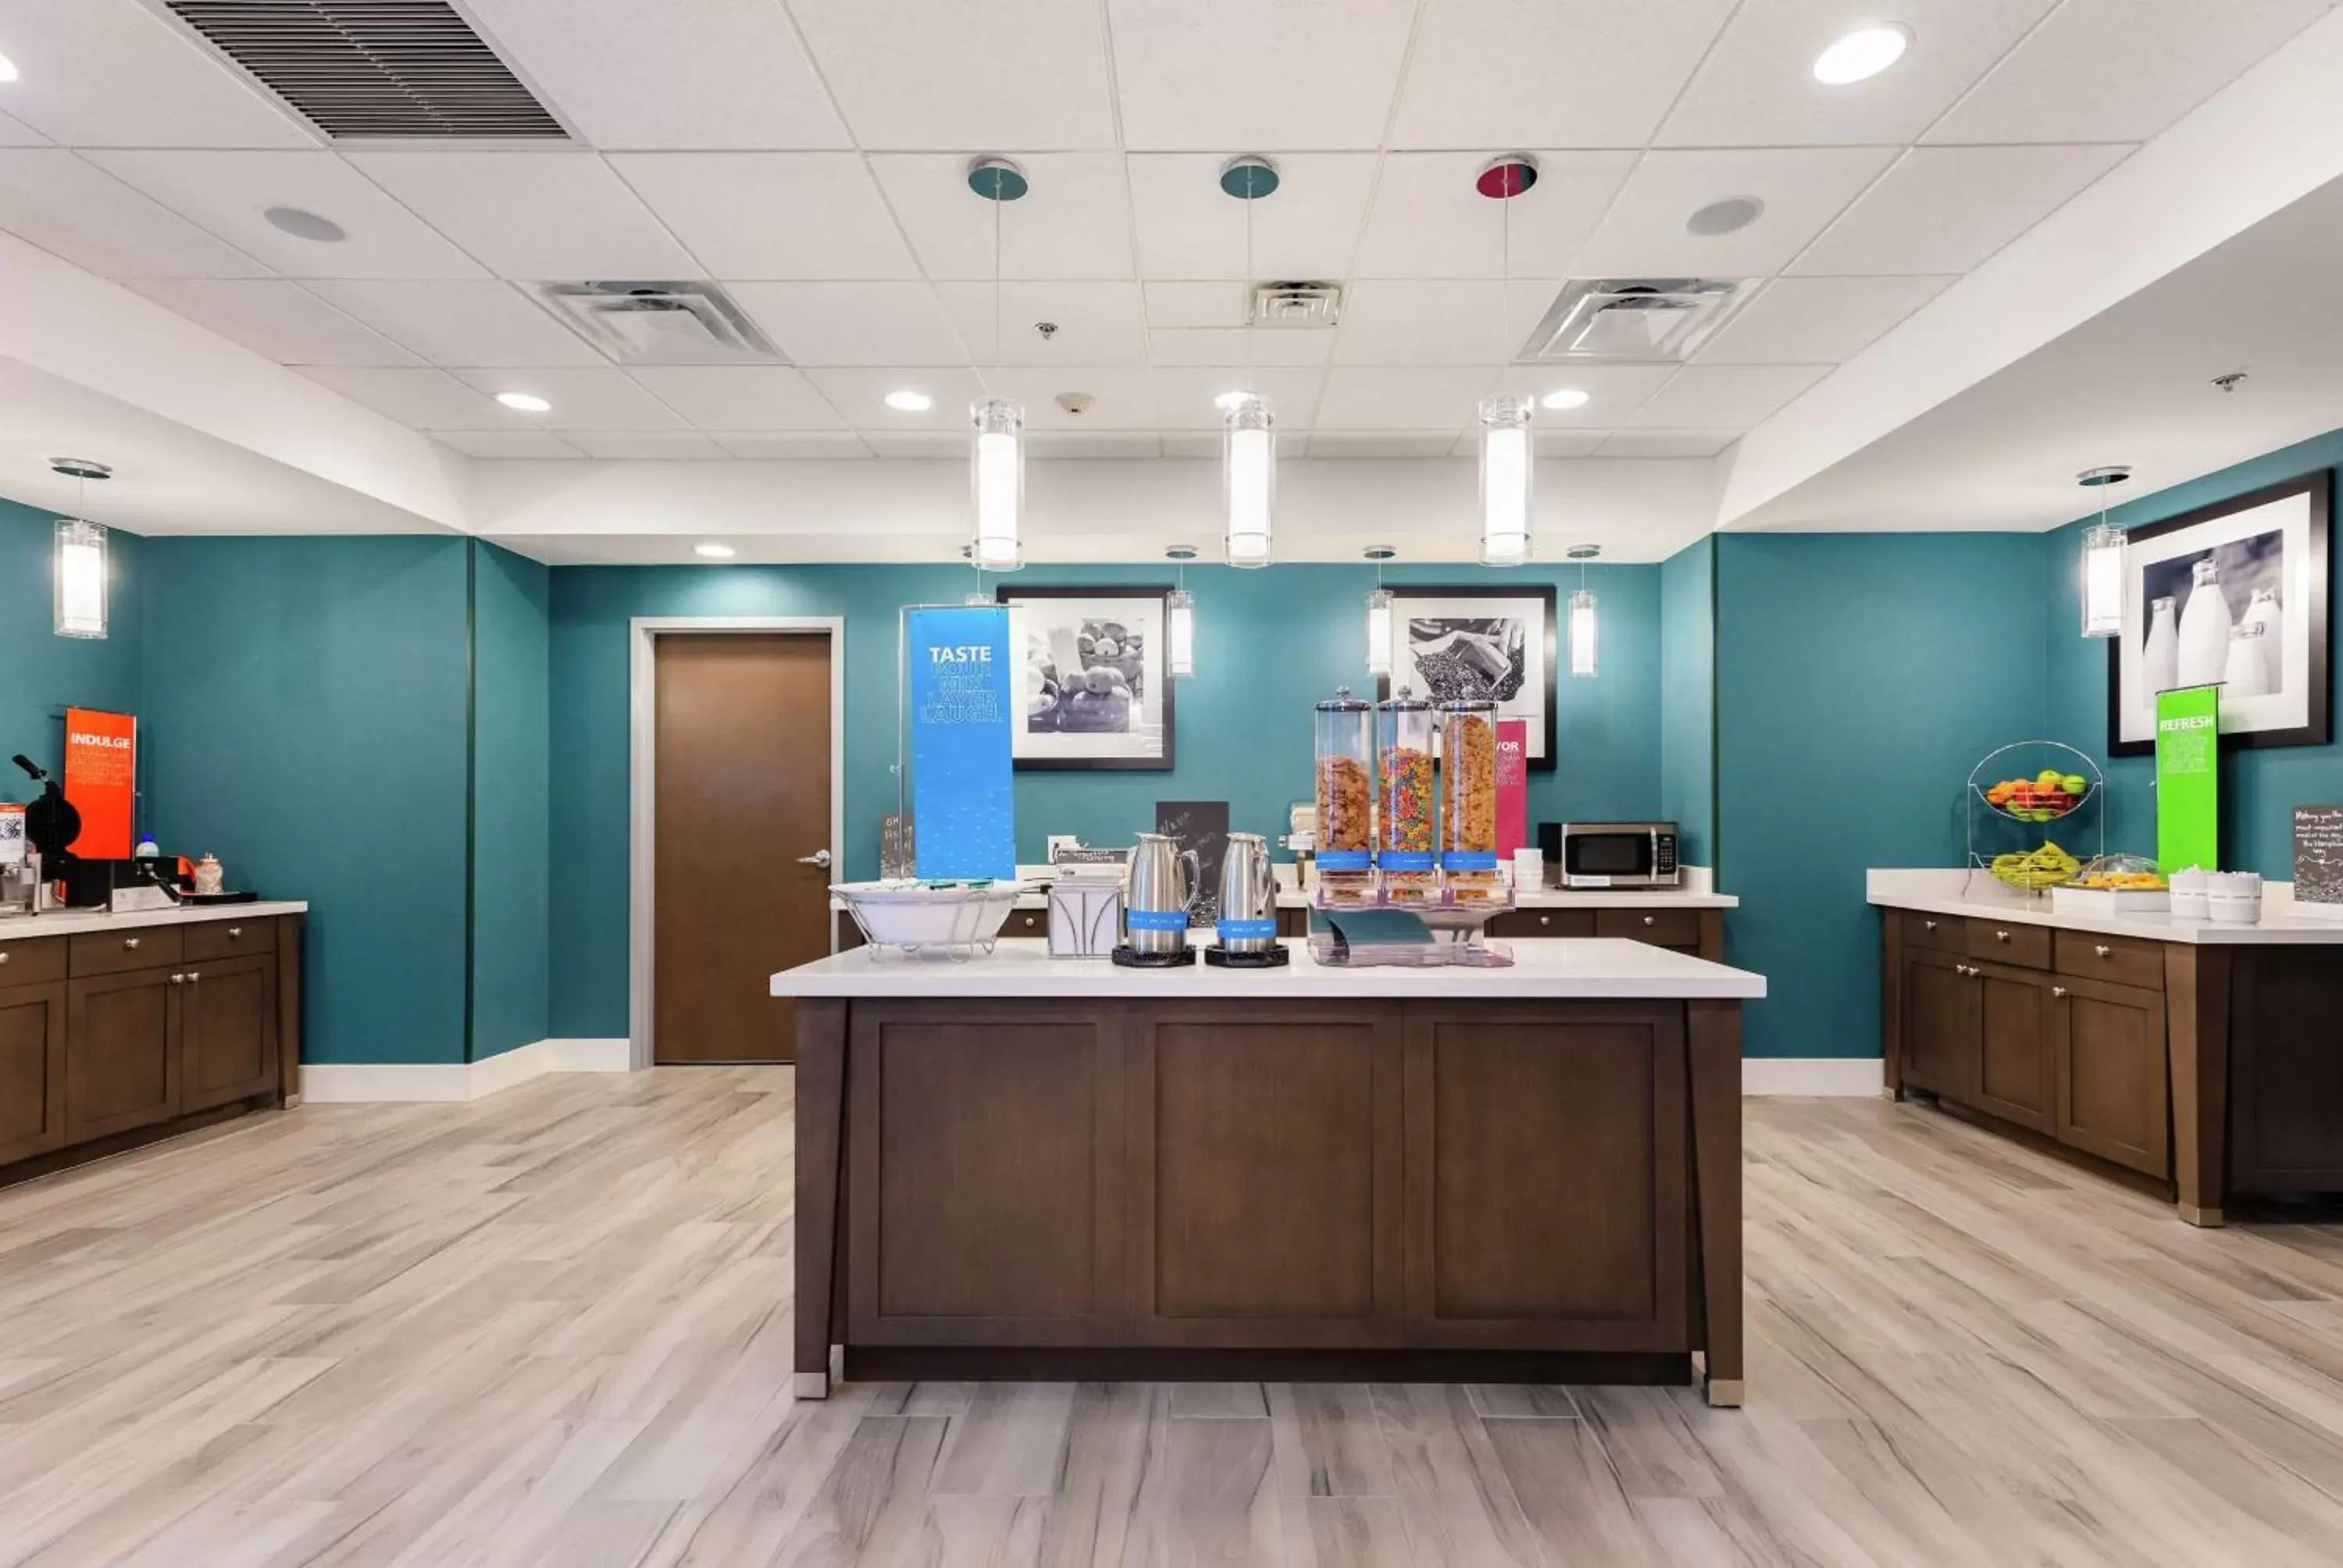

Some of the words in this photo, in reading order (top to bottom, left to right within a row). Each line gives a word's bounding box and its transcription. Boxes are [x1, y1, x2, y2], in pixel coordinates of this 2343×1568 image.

[929, 646, 991, 663] TASTE
[2159, 714, 2214, 732] REFRESH
[71, 732, 131, 749] INDULGE
